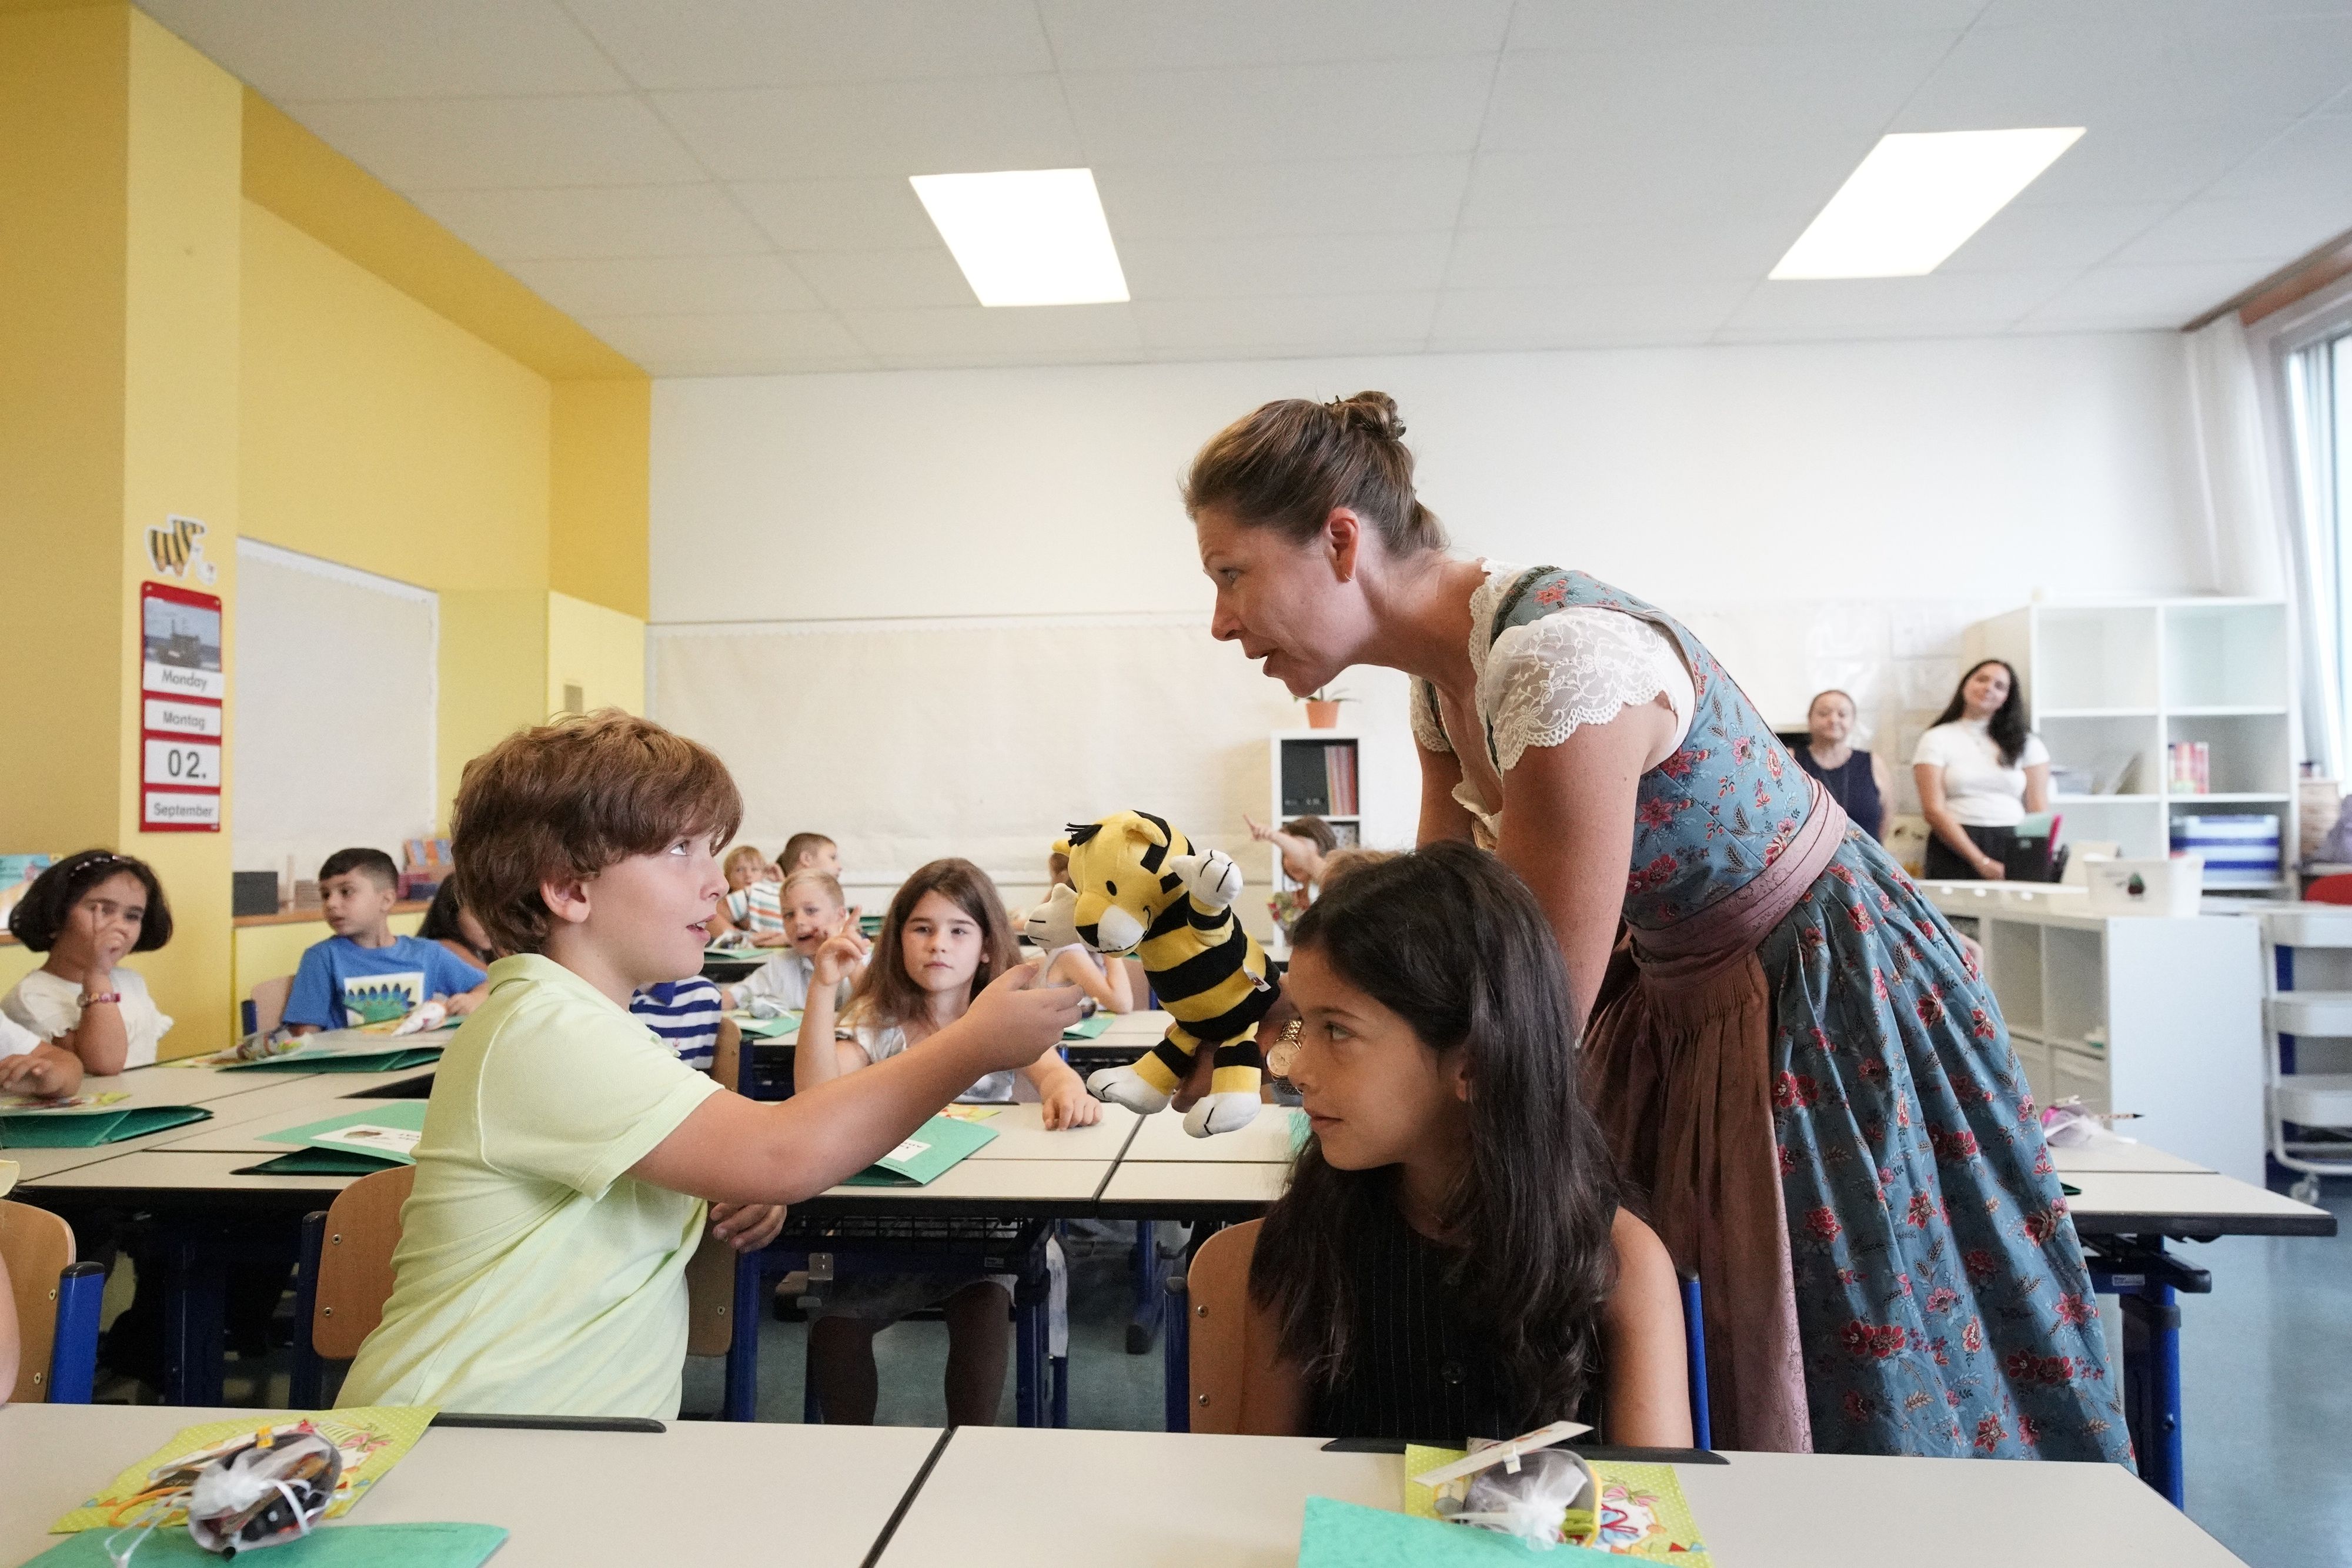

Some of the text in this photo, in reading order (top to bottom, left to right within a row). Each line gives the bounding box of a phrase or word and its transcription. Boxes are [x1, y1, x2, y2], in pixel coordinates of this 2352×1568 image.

[162, 669, 206, 691] Monday
[163, 711, 205, 730] Montag
[168, 750, 206, 778] 02.
[154, 802, 212, 818] September
